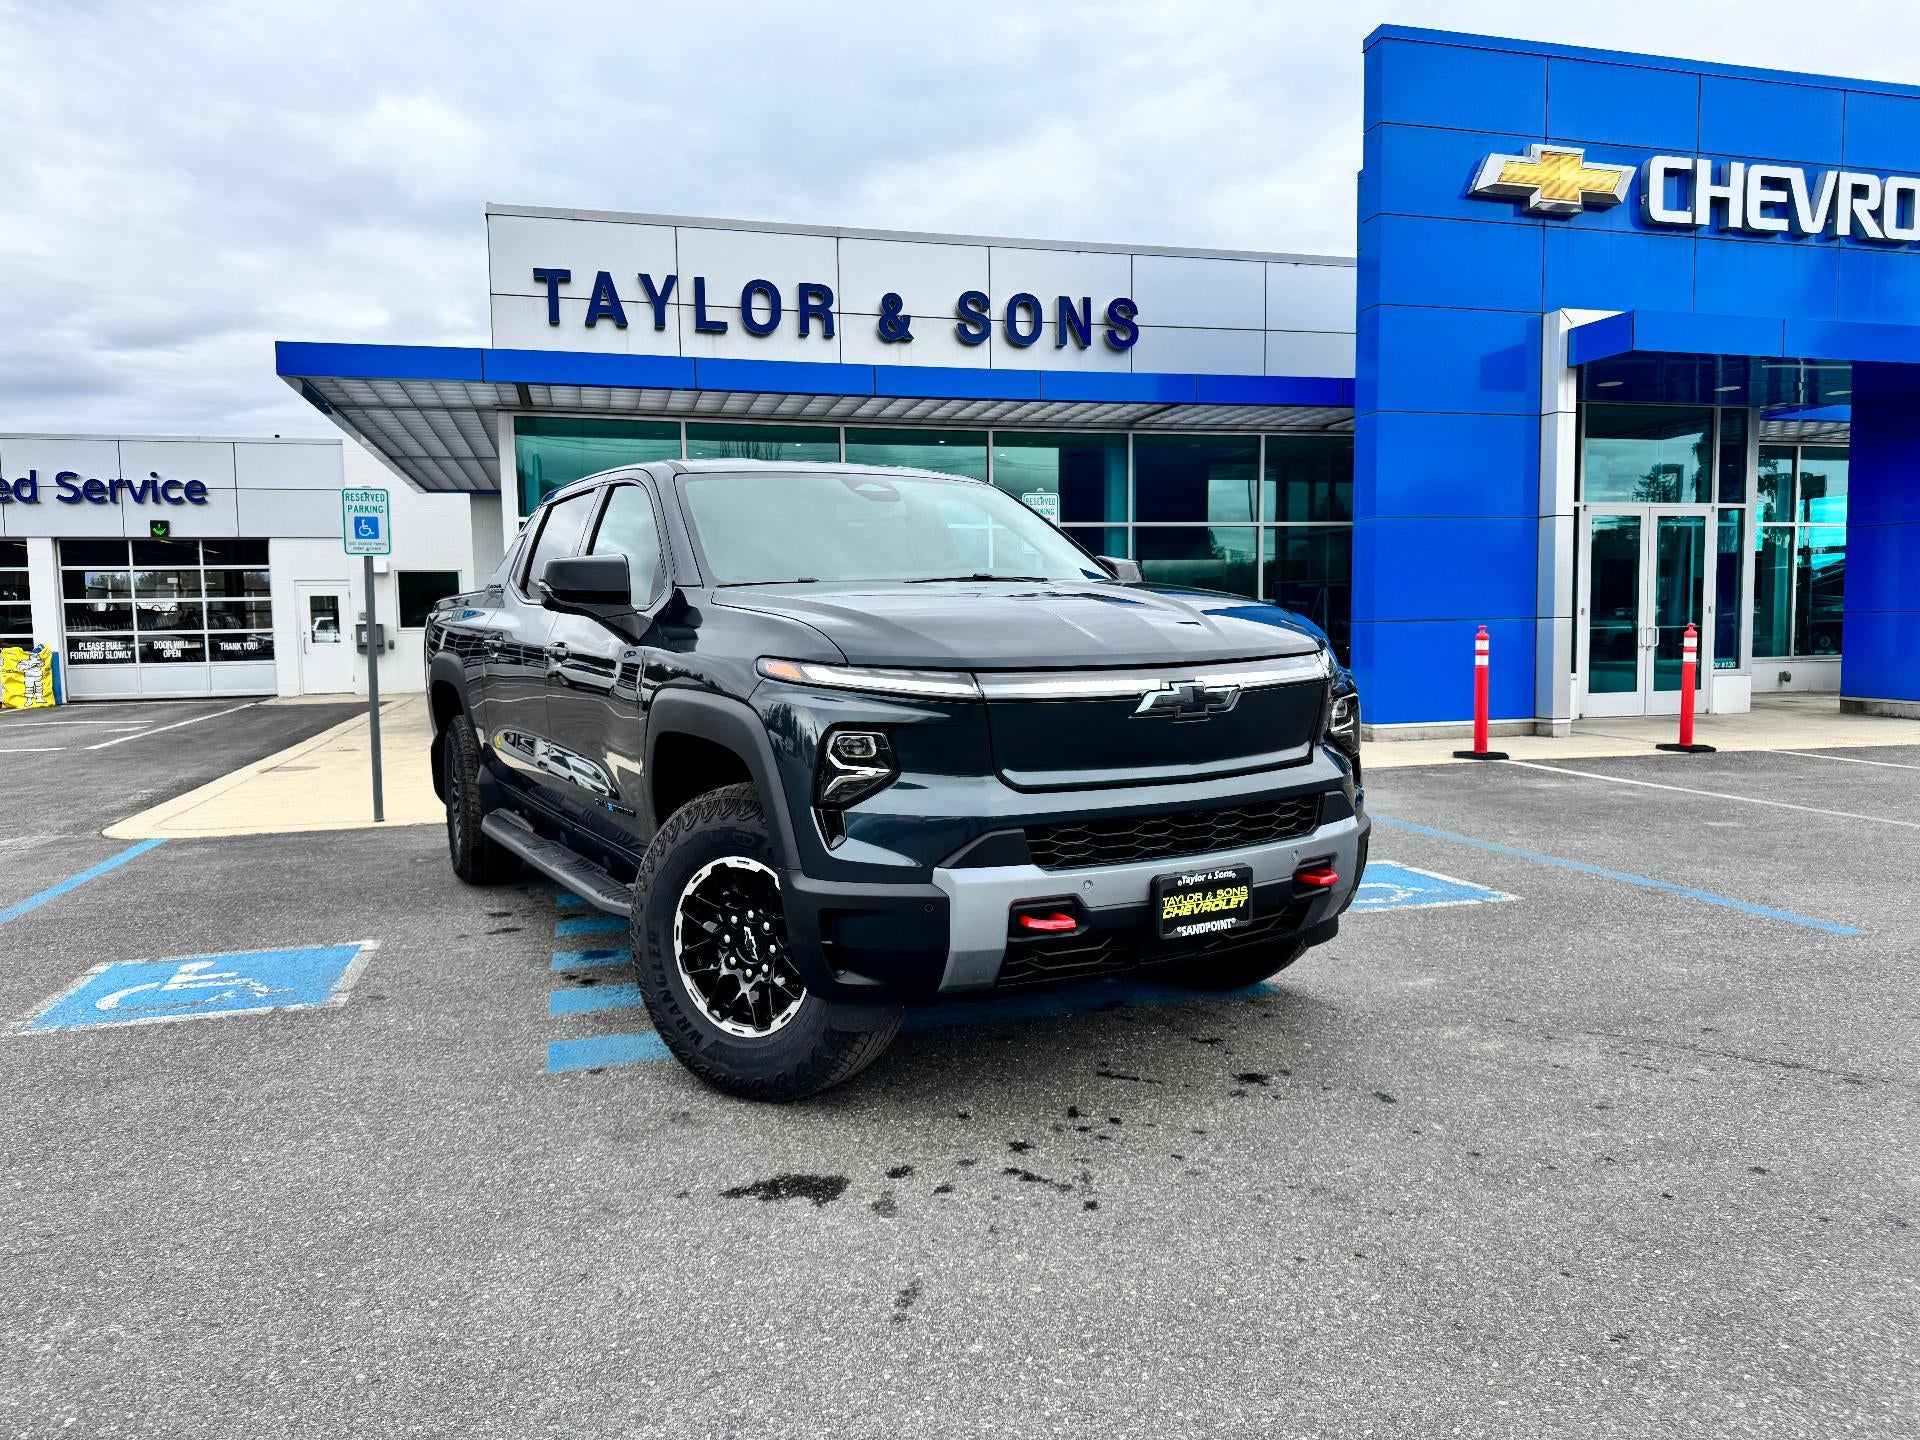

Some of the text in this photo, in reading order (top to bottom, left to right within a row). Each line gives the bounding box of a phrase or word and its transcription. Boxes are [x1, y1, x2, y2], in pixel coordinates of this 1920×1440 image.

[532, 267, 1140, 351] TAYLOR & SONS
[55, 471, 208, 505] Service
[345, 492, 385, 503] RESERVED
[347, 504, 384, 514] PARKING
[78, 642, 123, 651] PLEASE PULL
[153, 640, 190, 650] DOOR WILL
[219, 641, 258, 651] THANK YOU!
[70, 650, 132, 660] FORWARD SLOWLY
[163, 649, 182, 658] OPEN
[1182, 874, 1206, 886] Taylor
[1213, 870, 1233, 880] Sons
[1162, 886, 1248, 907] TAYLOR & SONS
[1162, 896, 1248, 919] CHEVROLET
[1181, 918, 1234, 937] SANDPOINT
